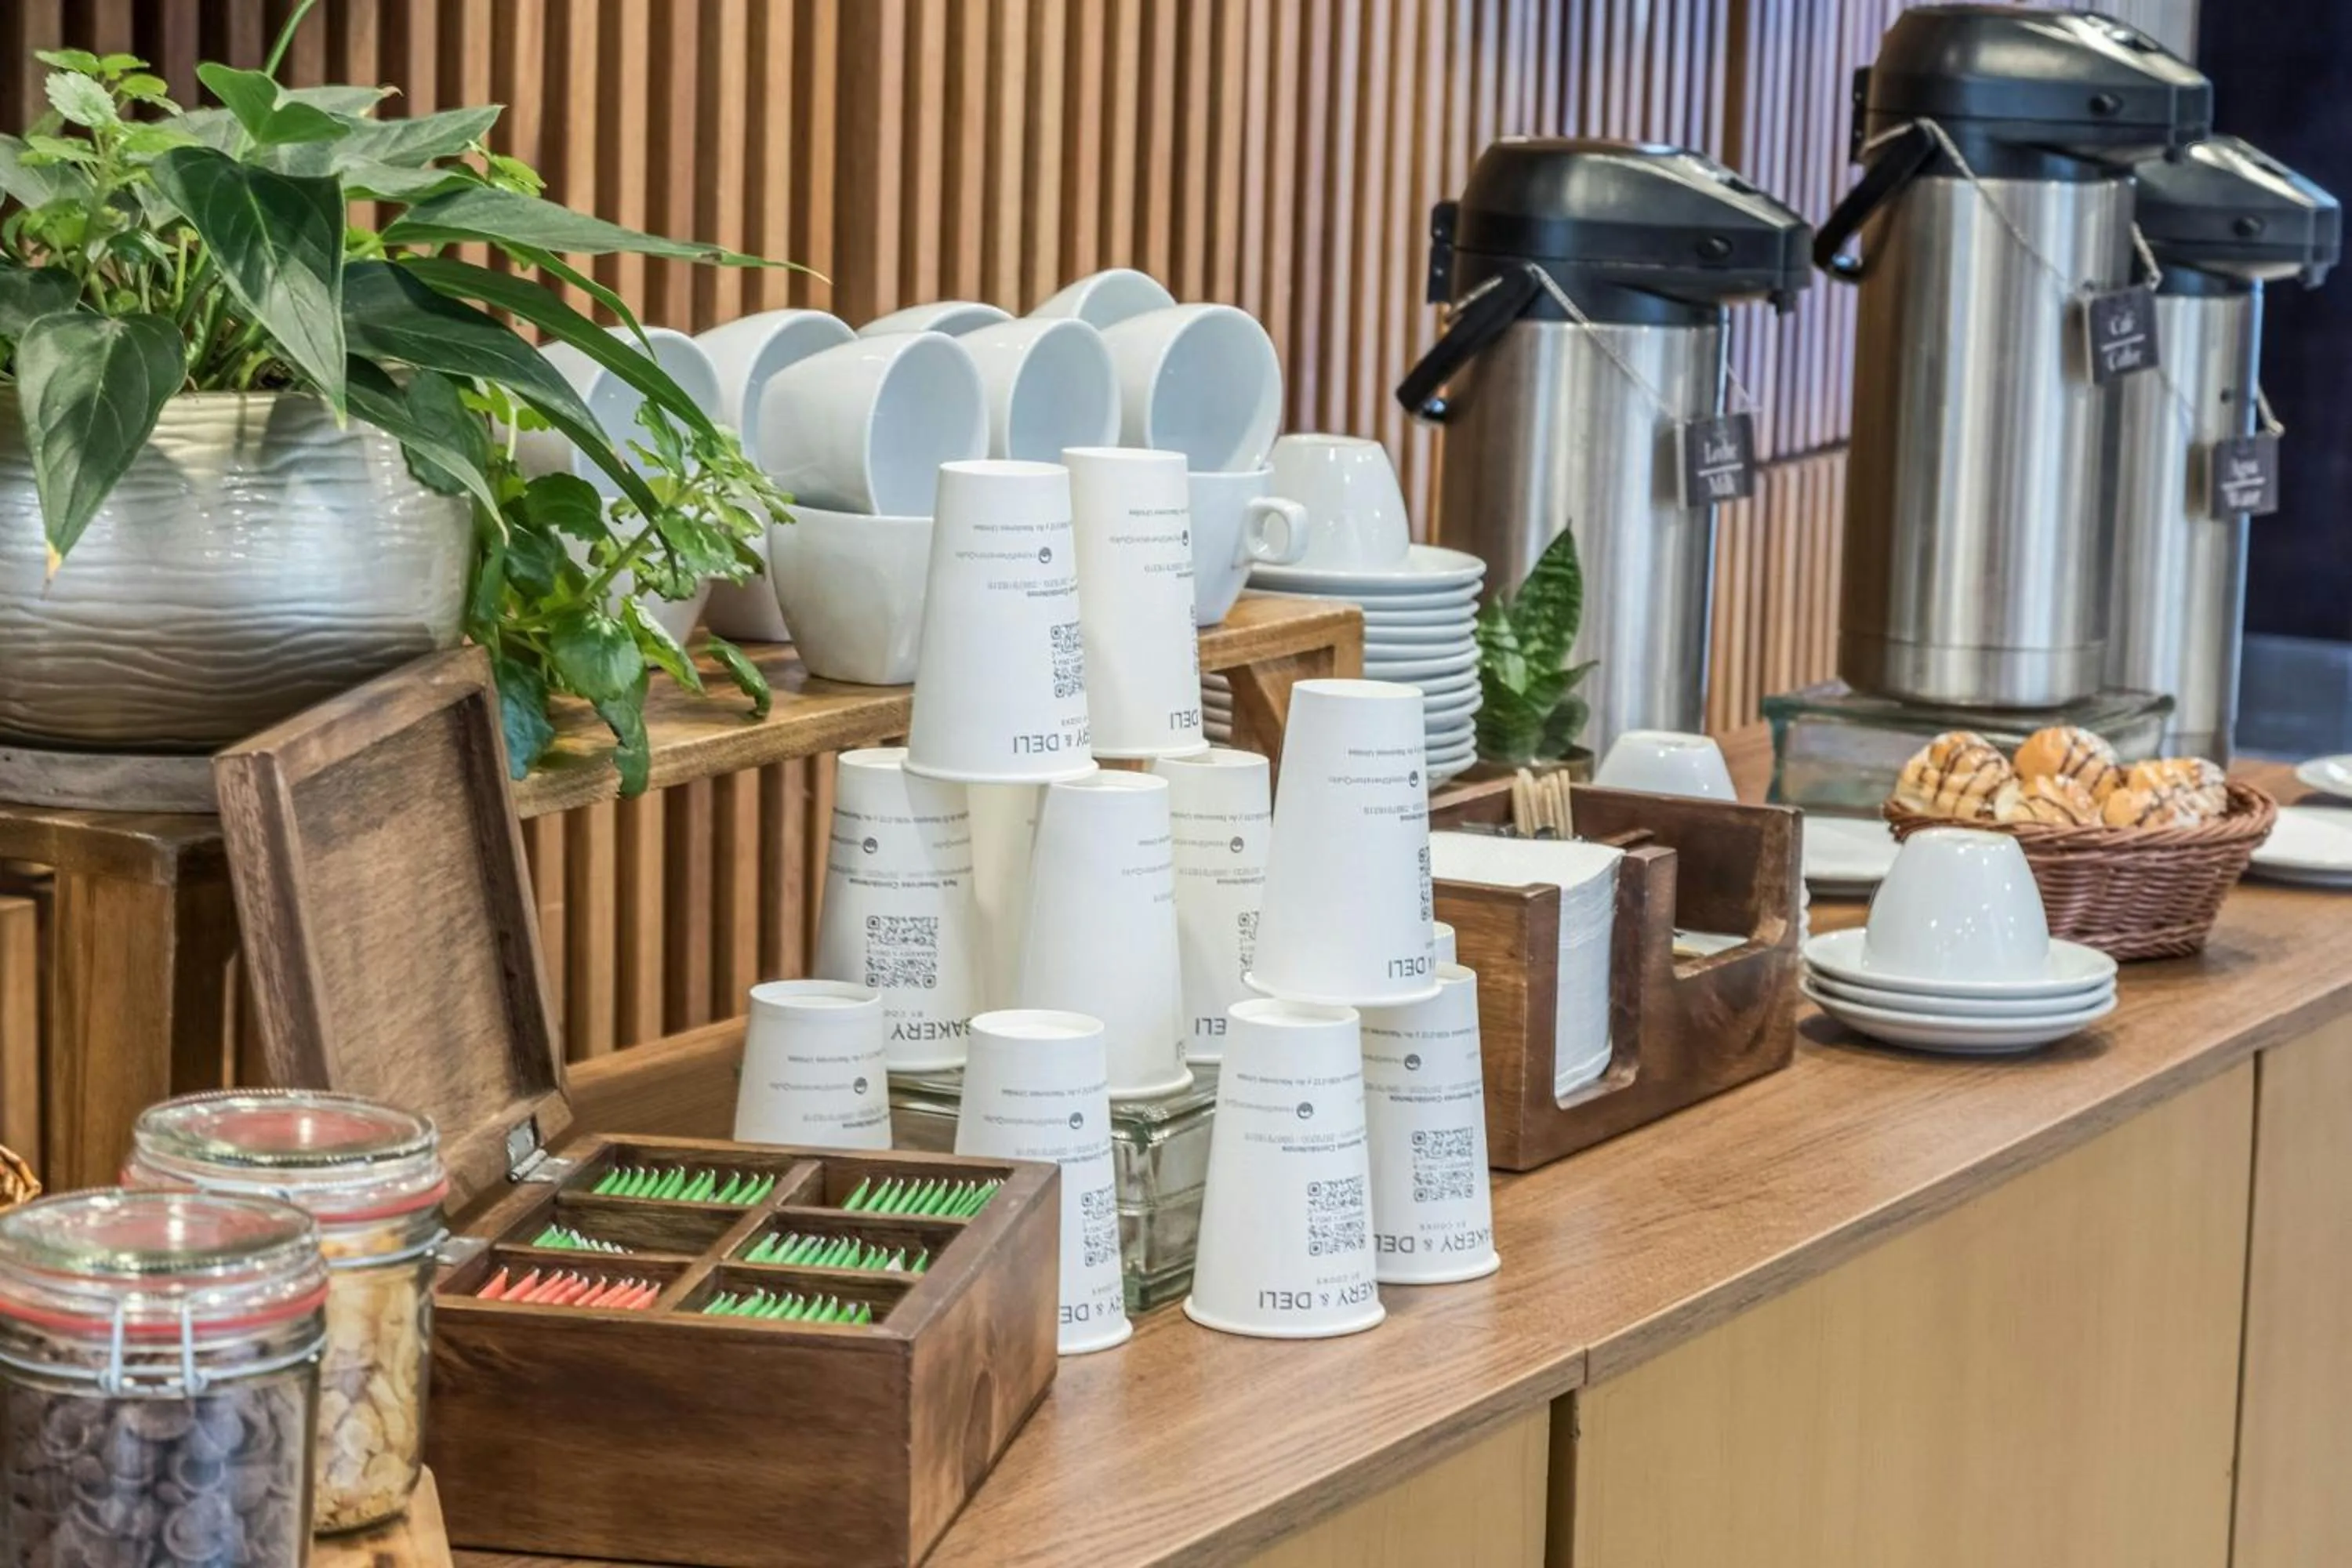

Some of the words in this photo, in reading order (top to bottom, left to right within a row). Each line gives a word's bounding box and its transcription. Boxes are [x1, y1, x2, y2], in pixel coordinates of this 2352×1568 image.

[1170, 708, 1199, 730] DELI
[1013, 733, 1060, 754] DELI
[1388, 956, 1426, 979] DELI
[1195, 1018, 1227, 1036] ELI
[1373, 1233, 1415, 1254] DEL
[1258, 1290, 1312, 1311] DELI
[1059, 1303, 1089, 1324] DE
